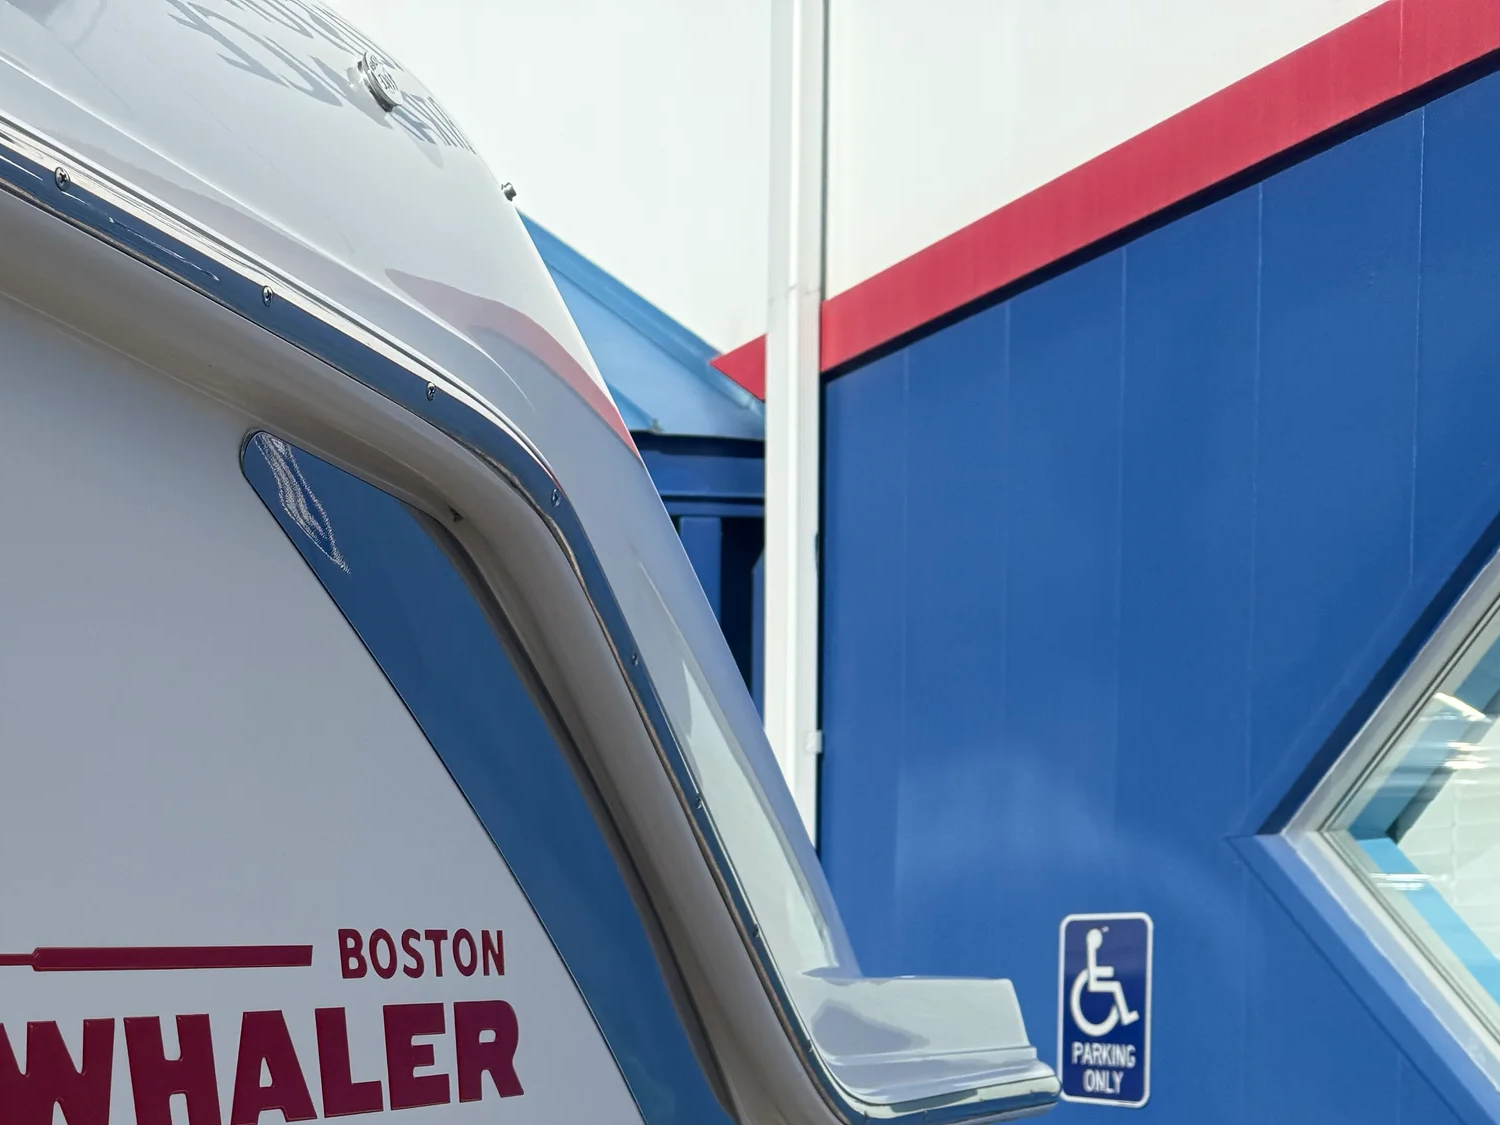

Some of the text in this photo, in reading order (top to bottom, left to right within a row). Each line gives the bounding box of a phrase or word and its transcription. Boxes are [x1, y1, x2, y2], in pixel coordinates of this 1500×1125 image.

[338, 928, 504, 979] BOSTON
[1072, 1041, 1136, 1068] PARKING
[1083, 1069, 1124, 1094] ONLY
